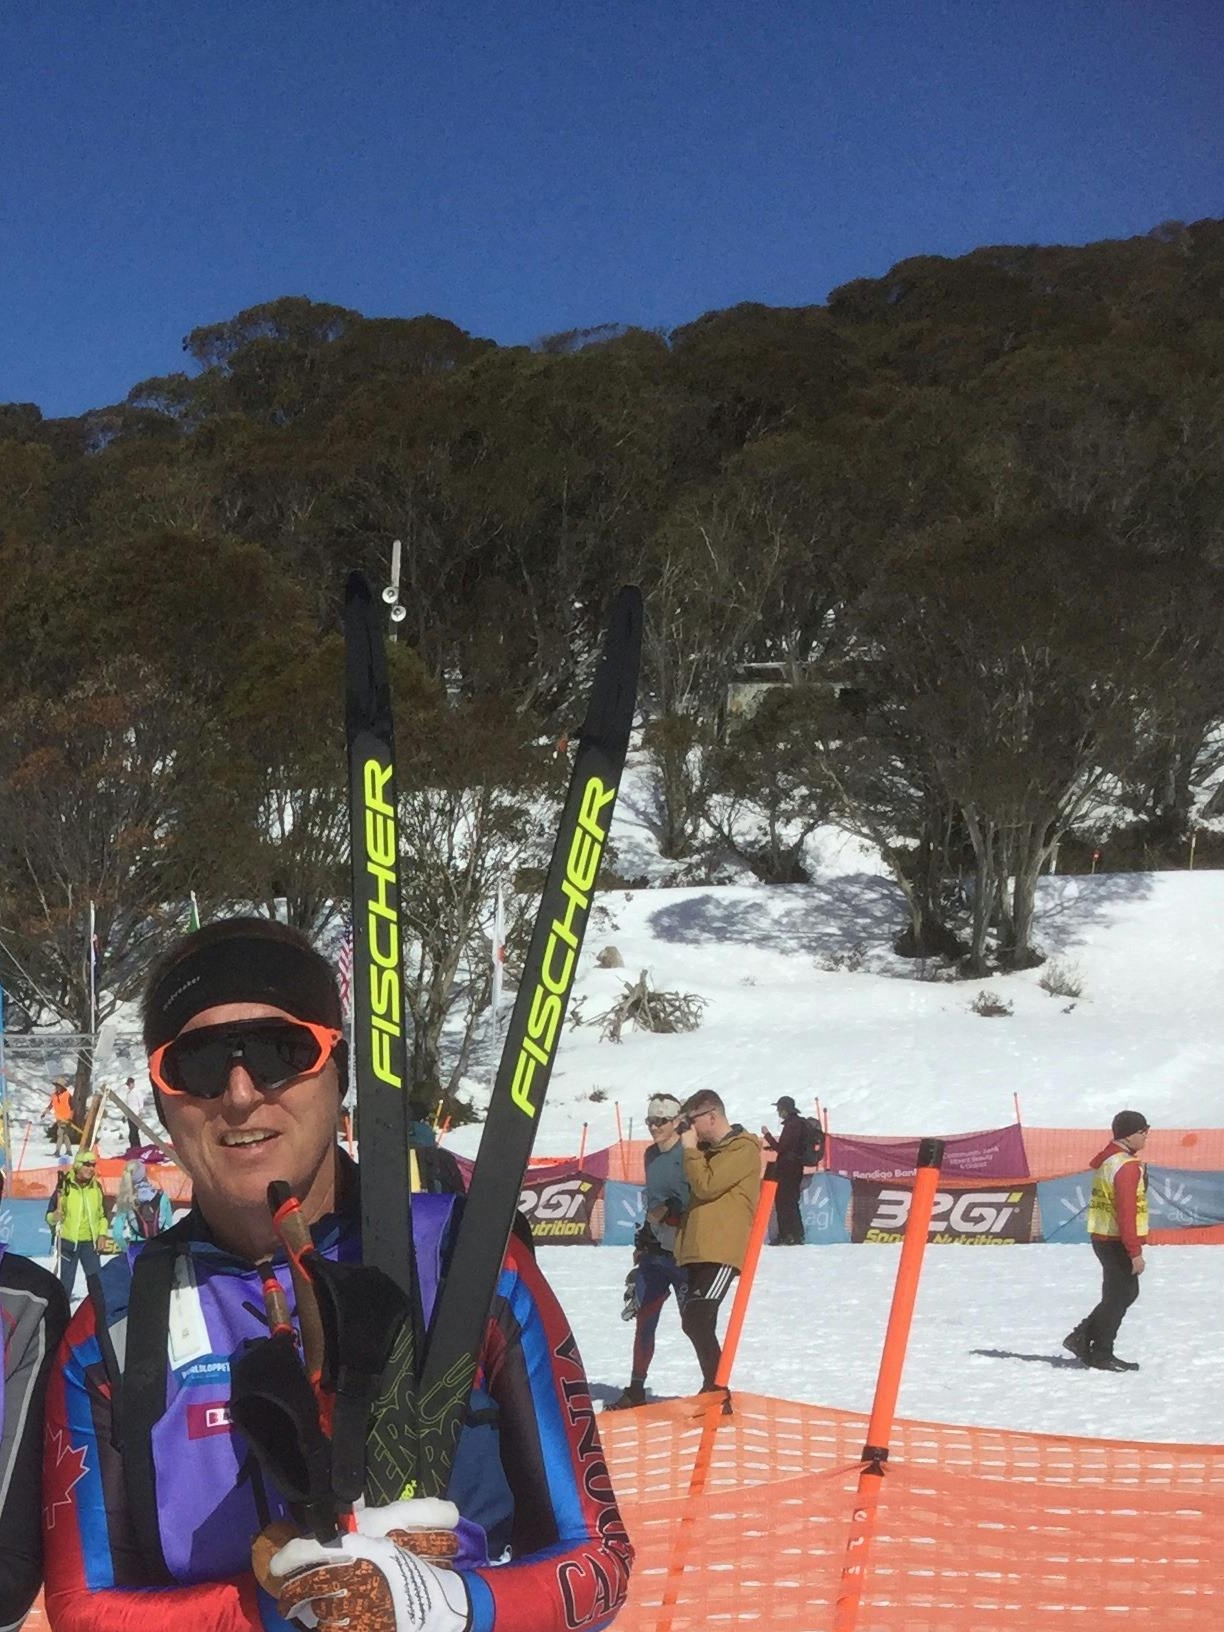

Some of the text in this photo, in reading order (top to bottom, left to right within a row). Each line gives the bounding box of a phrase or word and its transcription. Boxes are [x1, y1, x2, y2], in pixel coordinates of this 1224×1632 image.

[362, 759, 402, 1088] FISCHER
[510, 776, 616, 1119] FISCHER
[517, 1180, 593, 1219] 2Gi
[805, 1207, 834, 1231] agl
[530, 1220, 586, 1236] utrition
